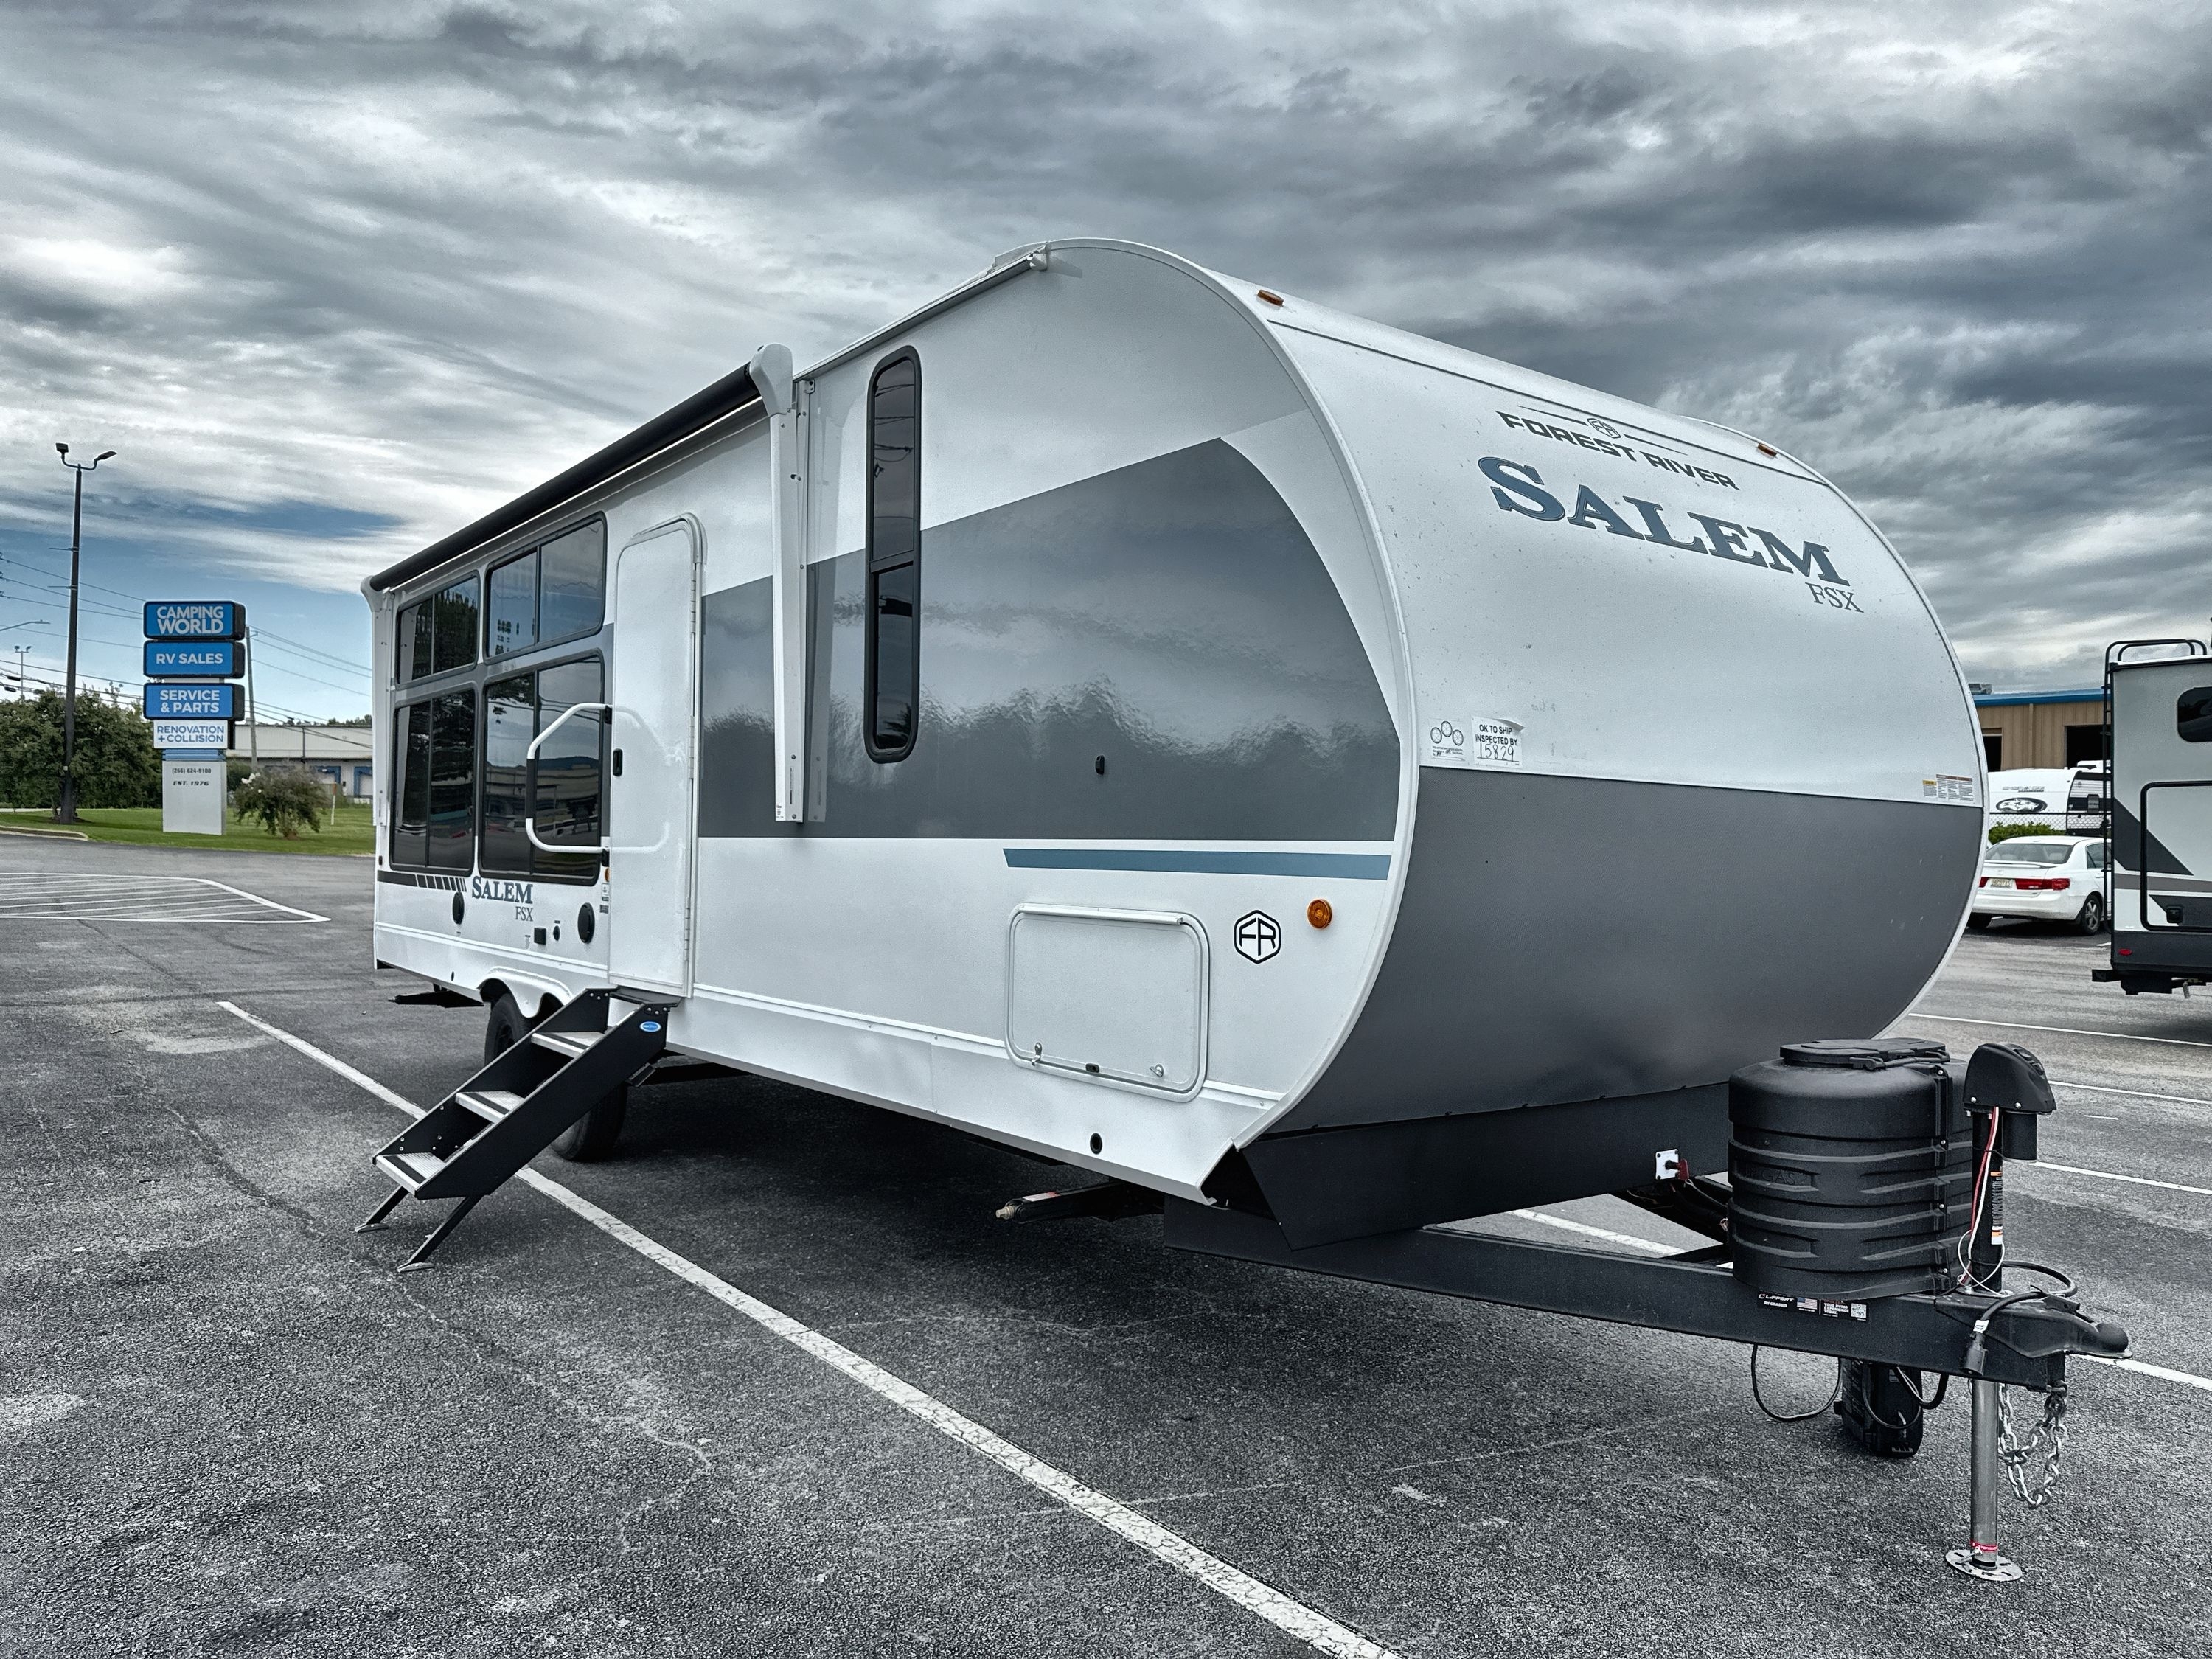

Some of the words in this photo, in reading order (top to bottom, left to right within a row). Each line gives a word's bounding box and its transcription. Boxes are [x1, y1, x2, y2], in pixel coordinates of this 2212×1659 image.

[1495, 410, 1637, 462] FOREST
[1639, 451, 1741, 491] RIVER
[1478, 456, 1851, 587] SALEM
[1804, 582, 1865, 613] FSX
[156, 605, 224, 619] CAMPING
[157, 619, 224, 634] WORLD
[156, 653, 176, 664] RV
[178, 653, 223, 664] SALES
[159, 689, 220, 701] SERVICE
[160, 702, 170, 713] &
[173, 702, 220, 713] PARTS
[156, 725, 225, 734] RENOVATION
[1479, 724, 1489, 733] OK
[1489, 725, 1498, 734] TO
[1498, 726, 1512, 735] SHIP
[167, 734, 223, 743] COLLISION
[1475, 734, 1509, 745] INSPECTED
[1509, 737, 1518, 746] BY
[1480, 742, 1514, 762] 15829
[472, 875, 534, 904] SALEM
[515, 906, 534, 922] FSX
[1239, 917, 1276, 956] FR
[1761, 1168, 1795, 1186] GAS
